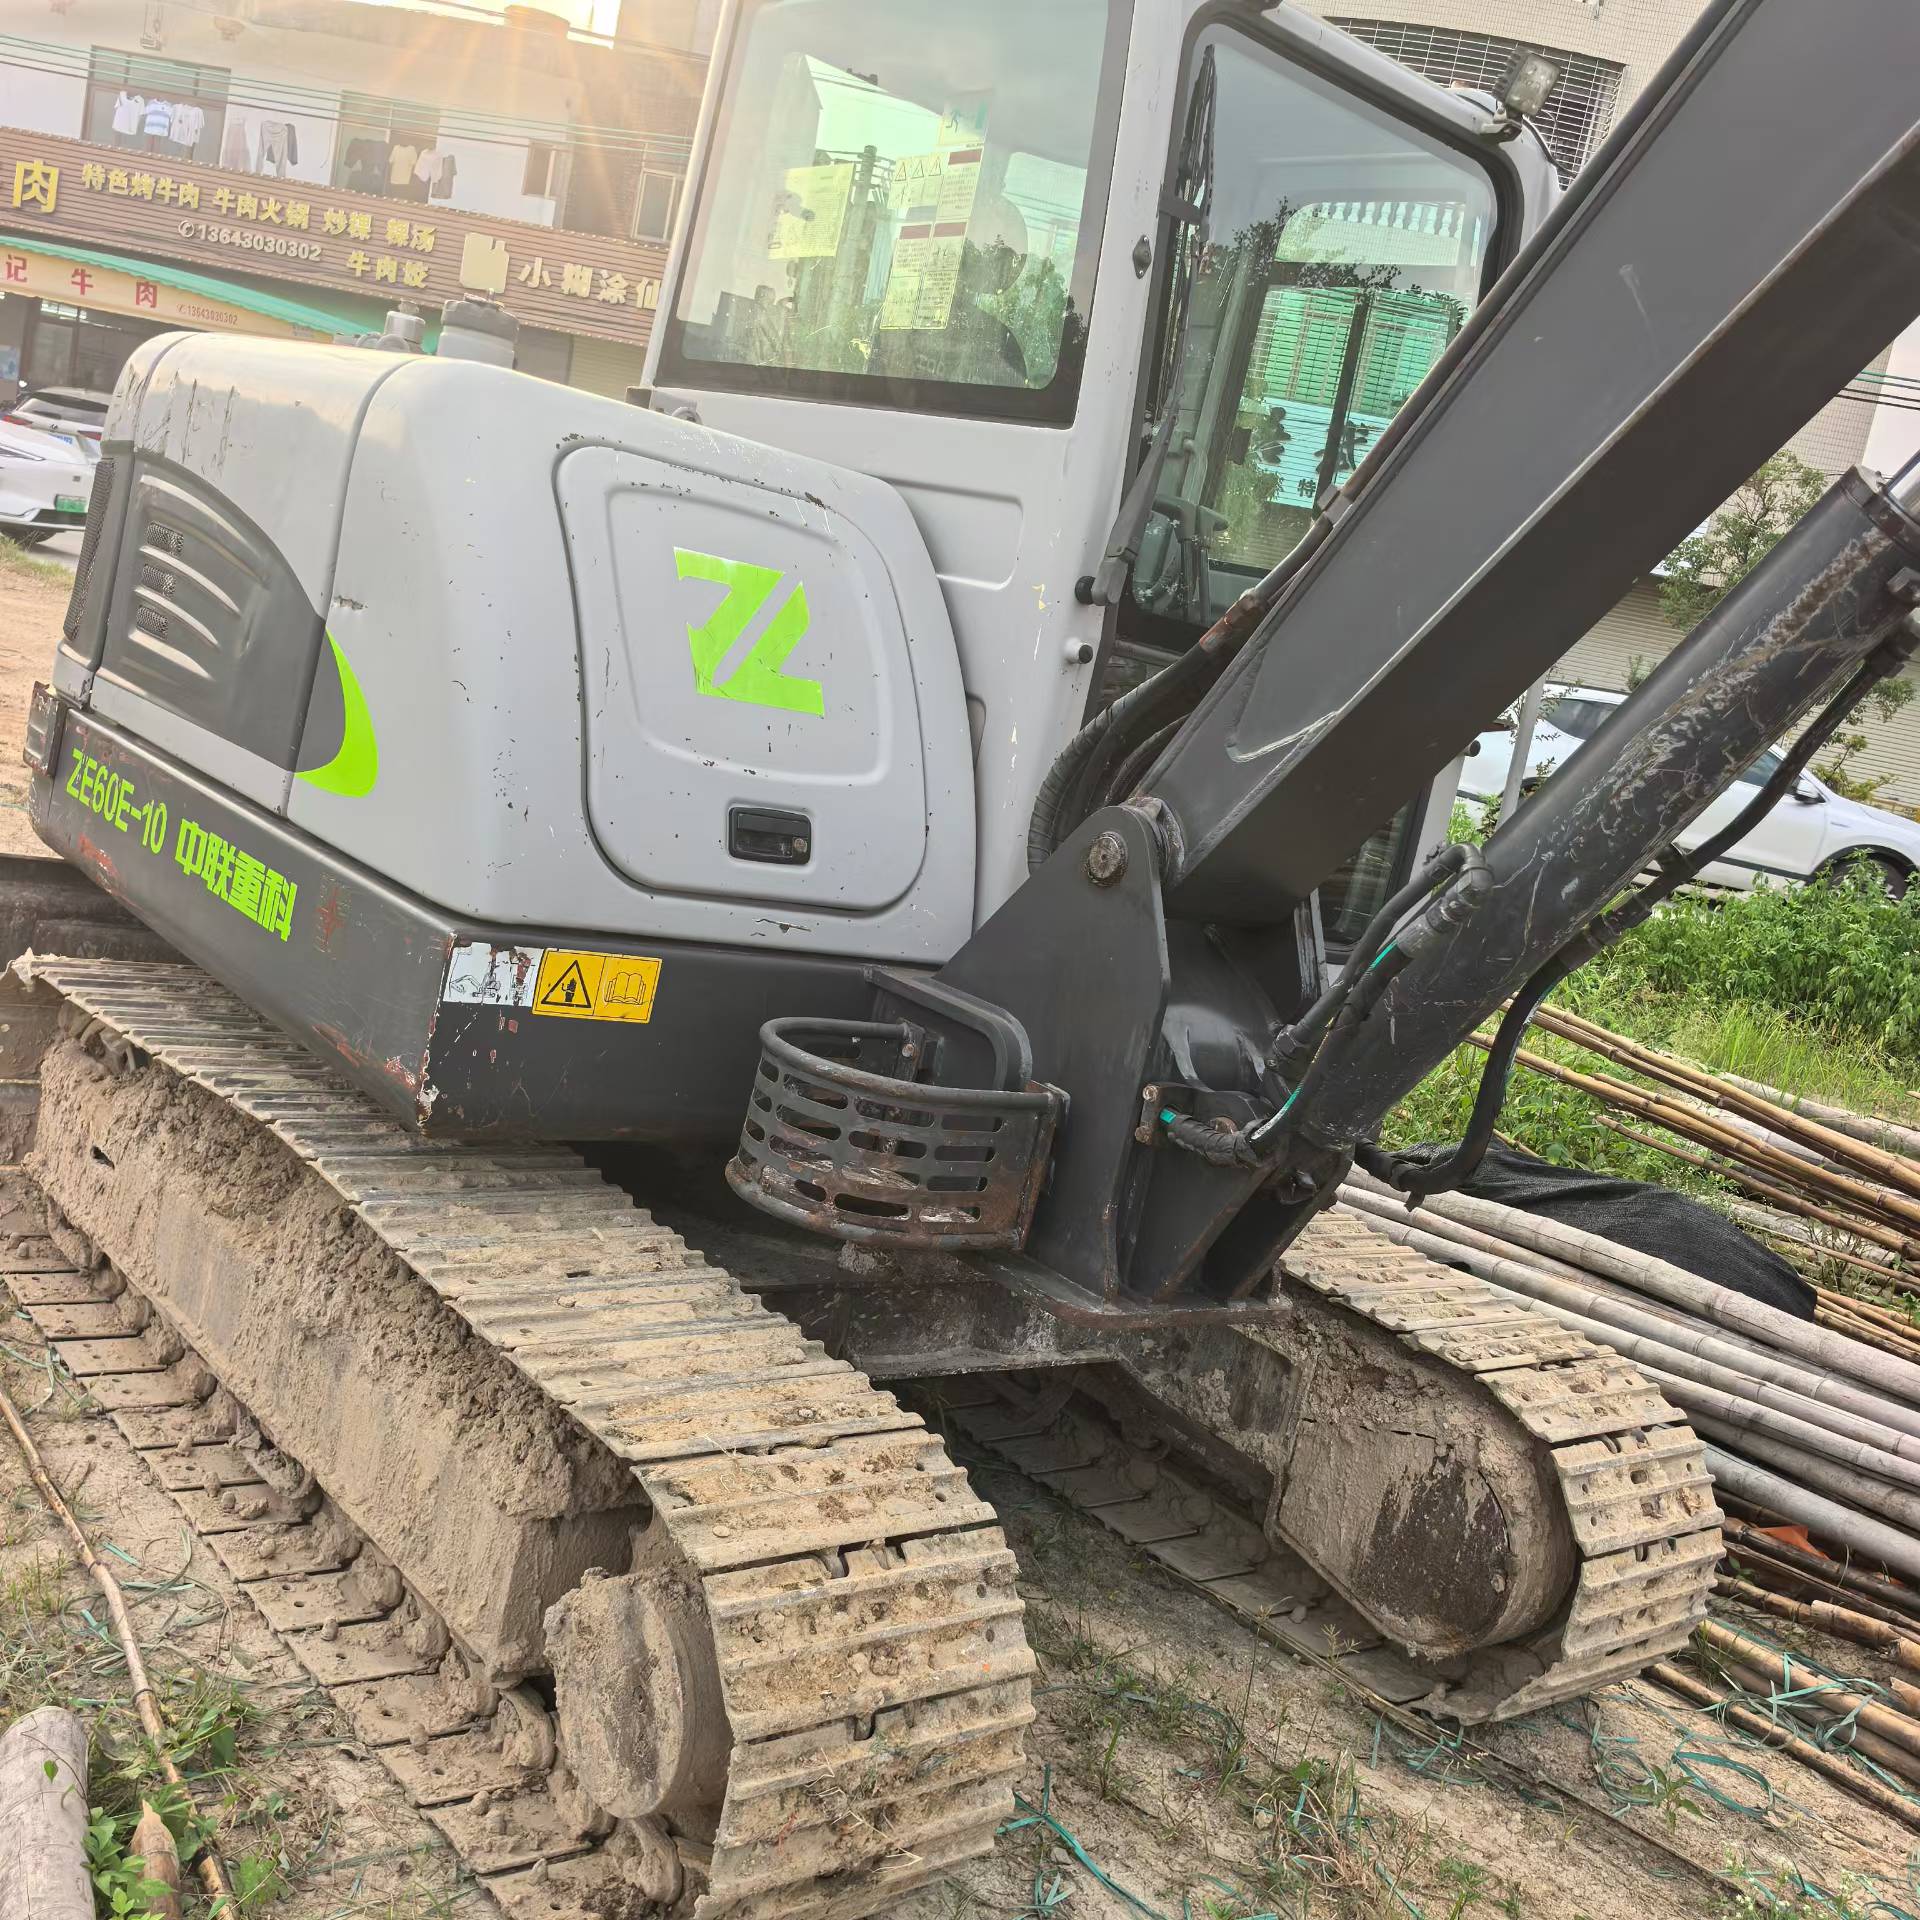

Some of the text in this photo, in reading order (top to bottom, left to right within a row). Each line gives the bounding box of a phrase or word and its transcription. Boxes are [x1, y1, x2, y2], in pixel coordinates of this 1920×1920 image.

[12, 160, 59, 213] 肉
[212, 187, 310, 230] 牛肉火锅
[199, 223, 322, 262] 13643030302
[66, 747, 297, 941] ZE60E-10 中联重科
